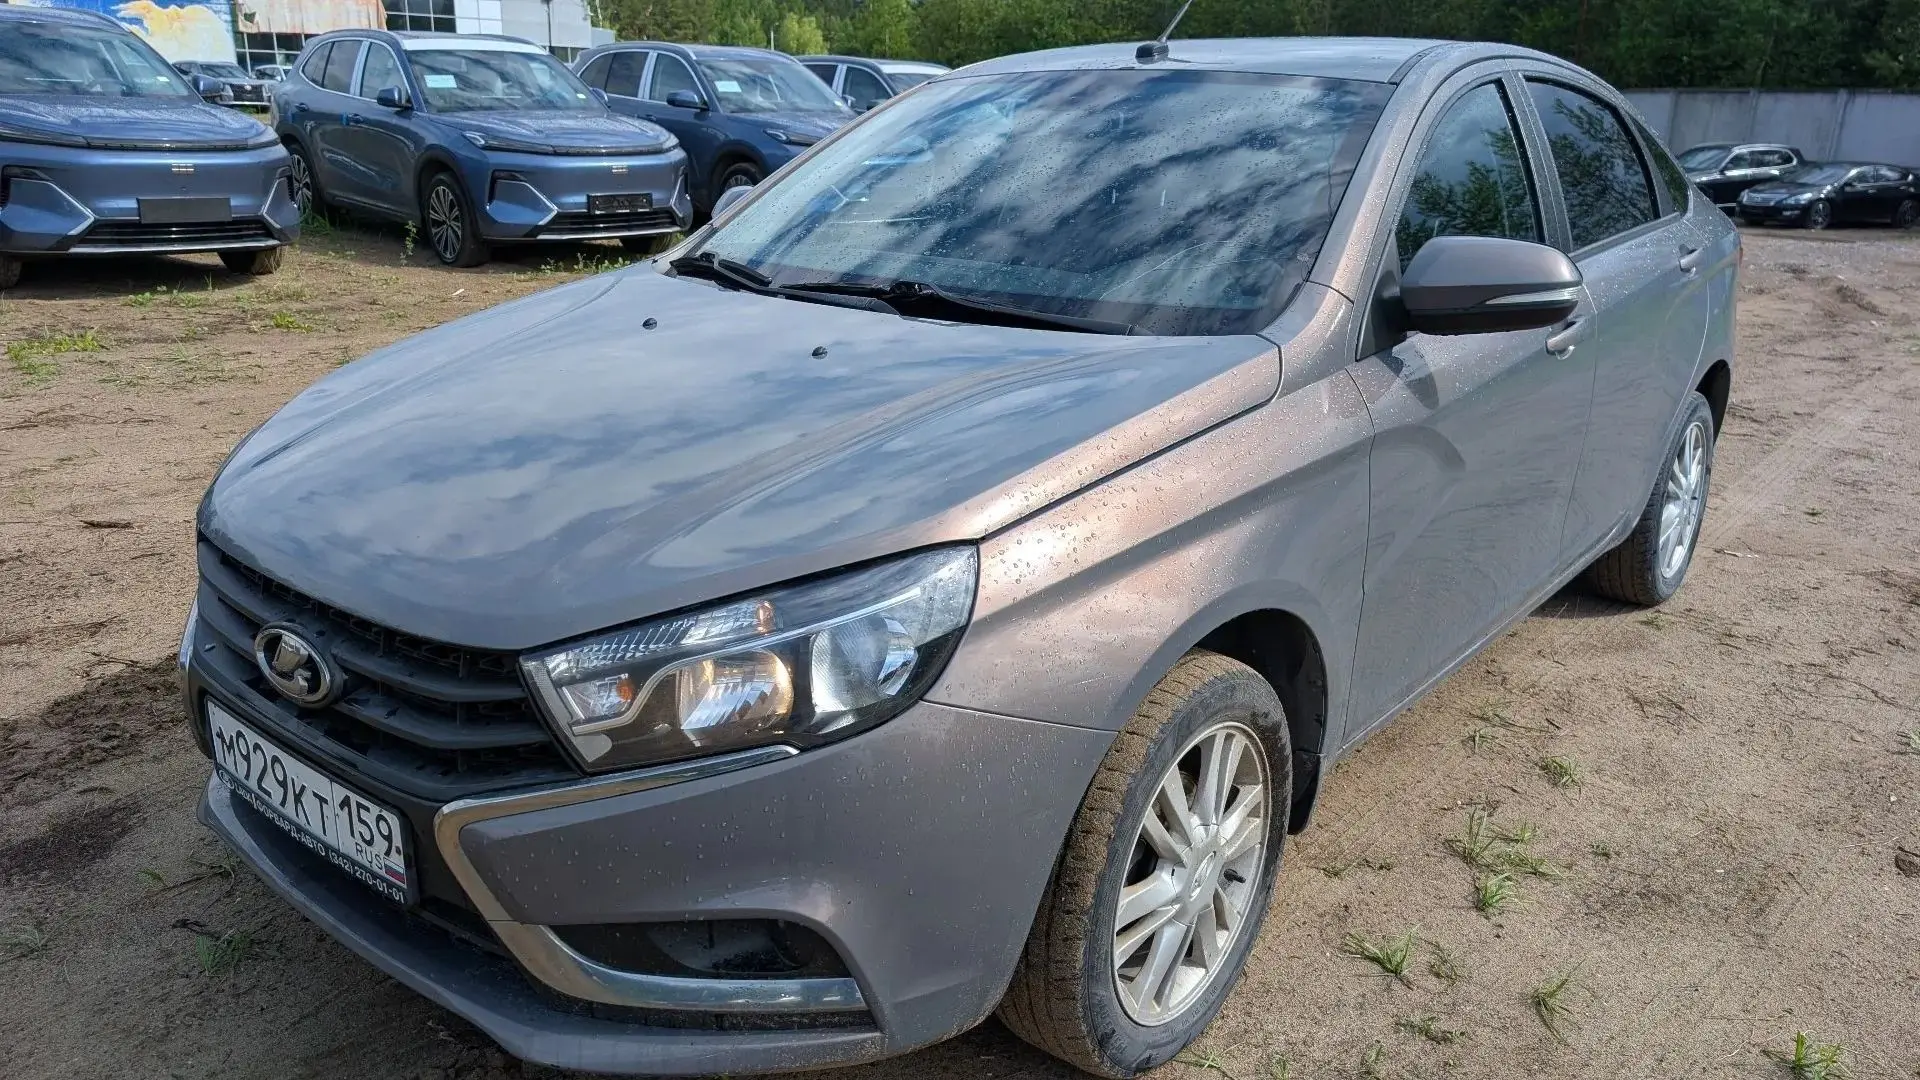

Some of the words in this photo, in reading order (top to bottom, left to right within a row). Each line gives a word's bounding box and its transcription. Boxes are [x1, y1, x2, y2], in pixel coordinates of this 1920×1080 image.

[216, 726, 328, 837] М929КТ
[339, 793, 393, 858] 159
[328, 849, 354, 875] (342)
[354, 866, 405, 904] 270-01-01
[355, 841, 383, 871] RUS
